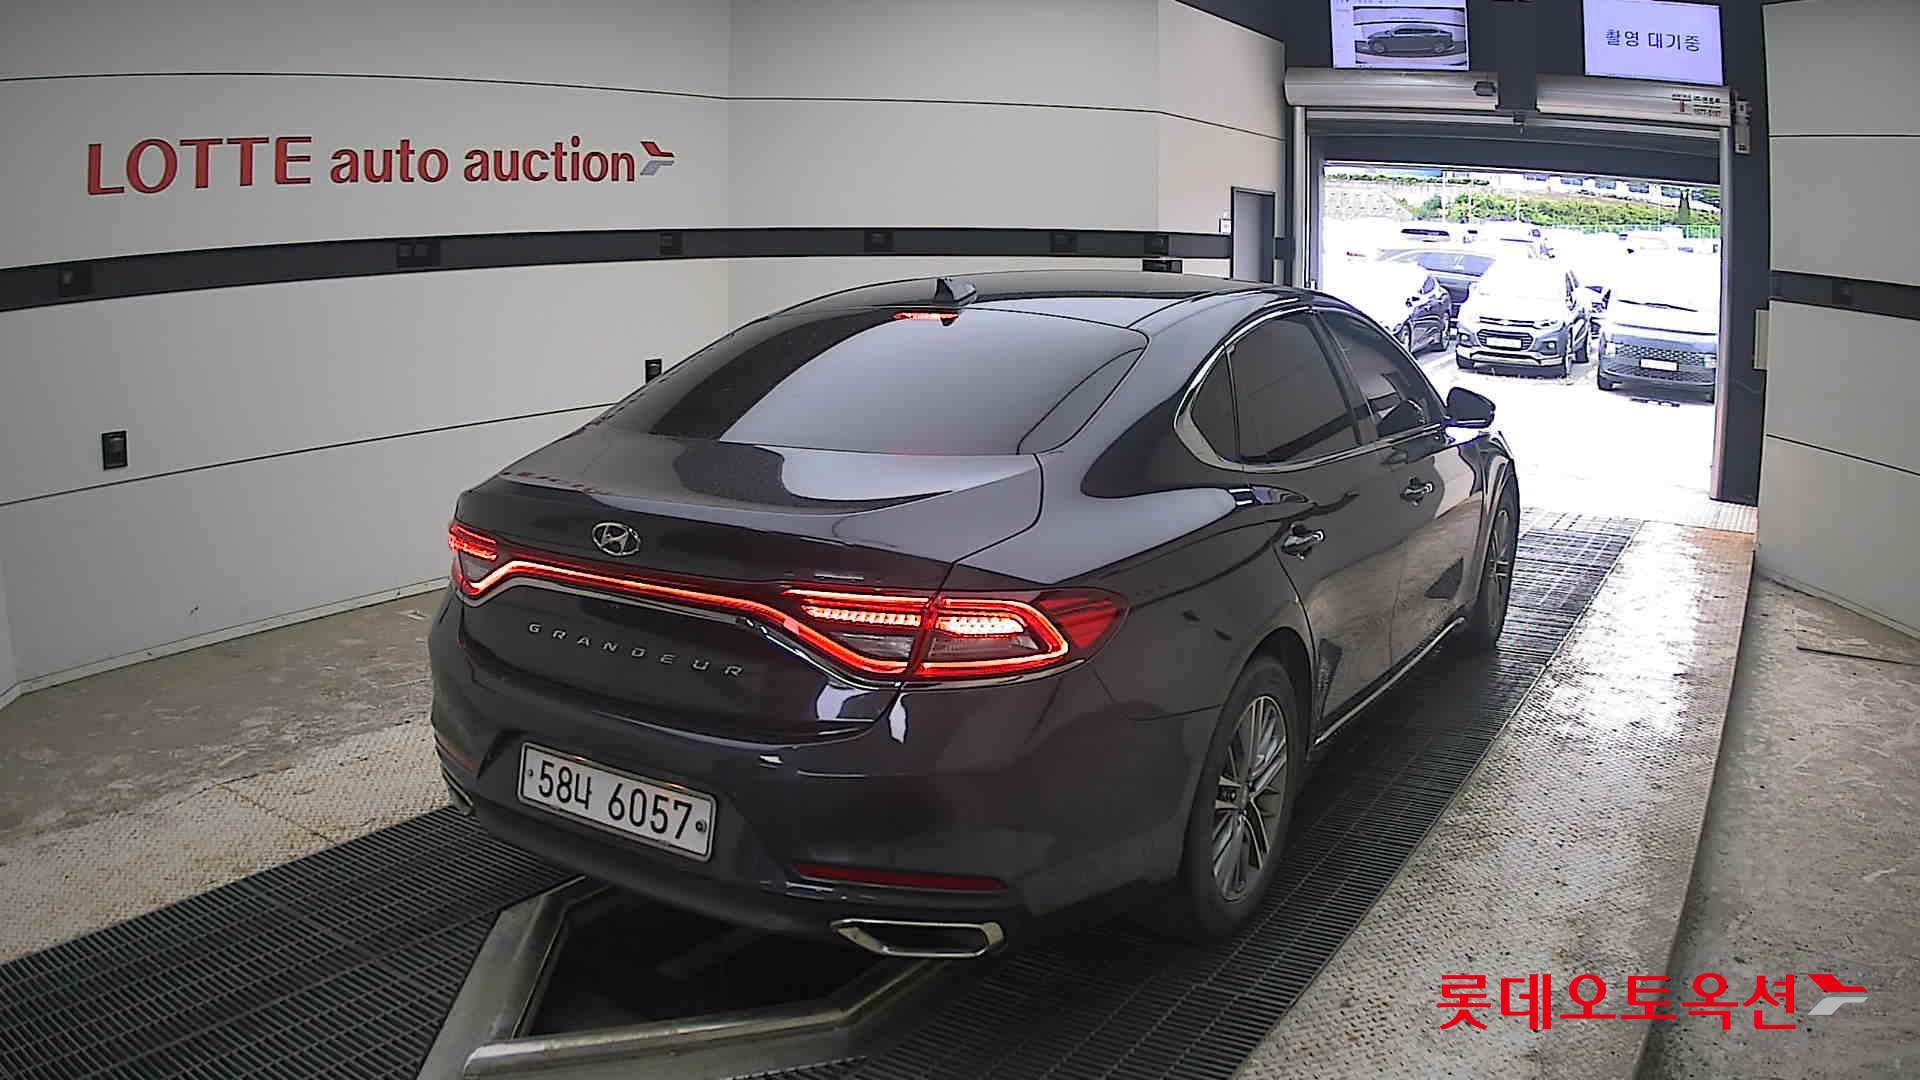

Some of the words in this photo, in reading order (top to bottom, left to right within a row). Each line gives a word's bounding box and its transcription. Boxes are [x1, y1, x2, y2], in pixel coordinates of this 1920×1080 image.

[1647, 32, 1701, 51] 대기중
[87, 136, 312, 195] LOTTE
[329, 139, 449, 184] auto
[463, 135, 636, 182] auction
[528, 622, 744, 677] GRANDEUR
[538, 760, 592, 810] 58나
[608, 783, 692, 839] 6057
